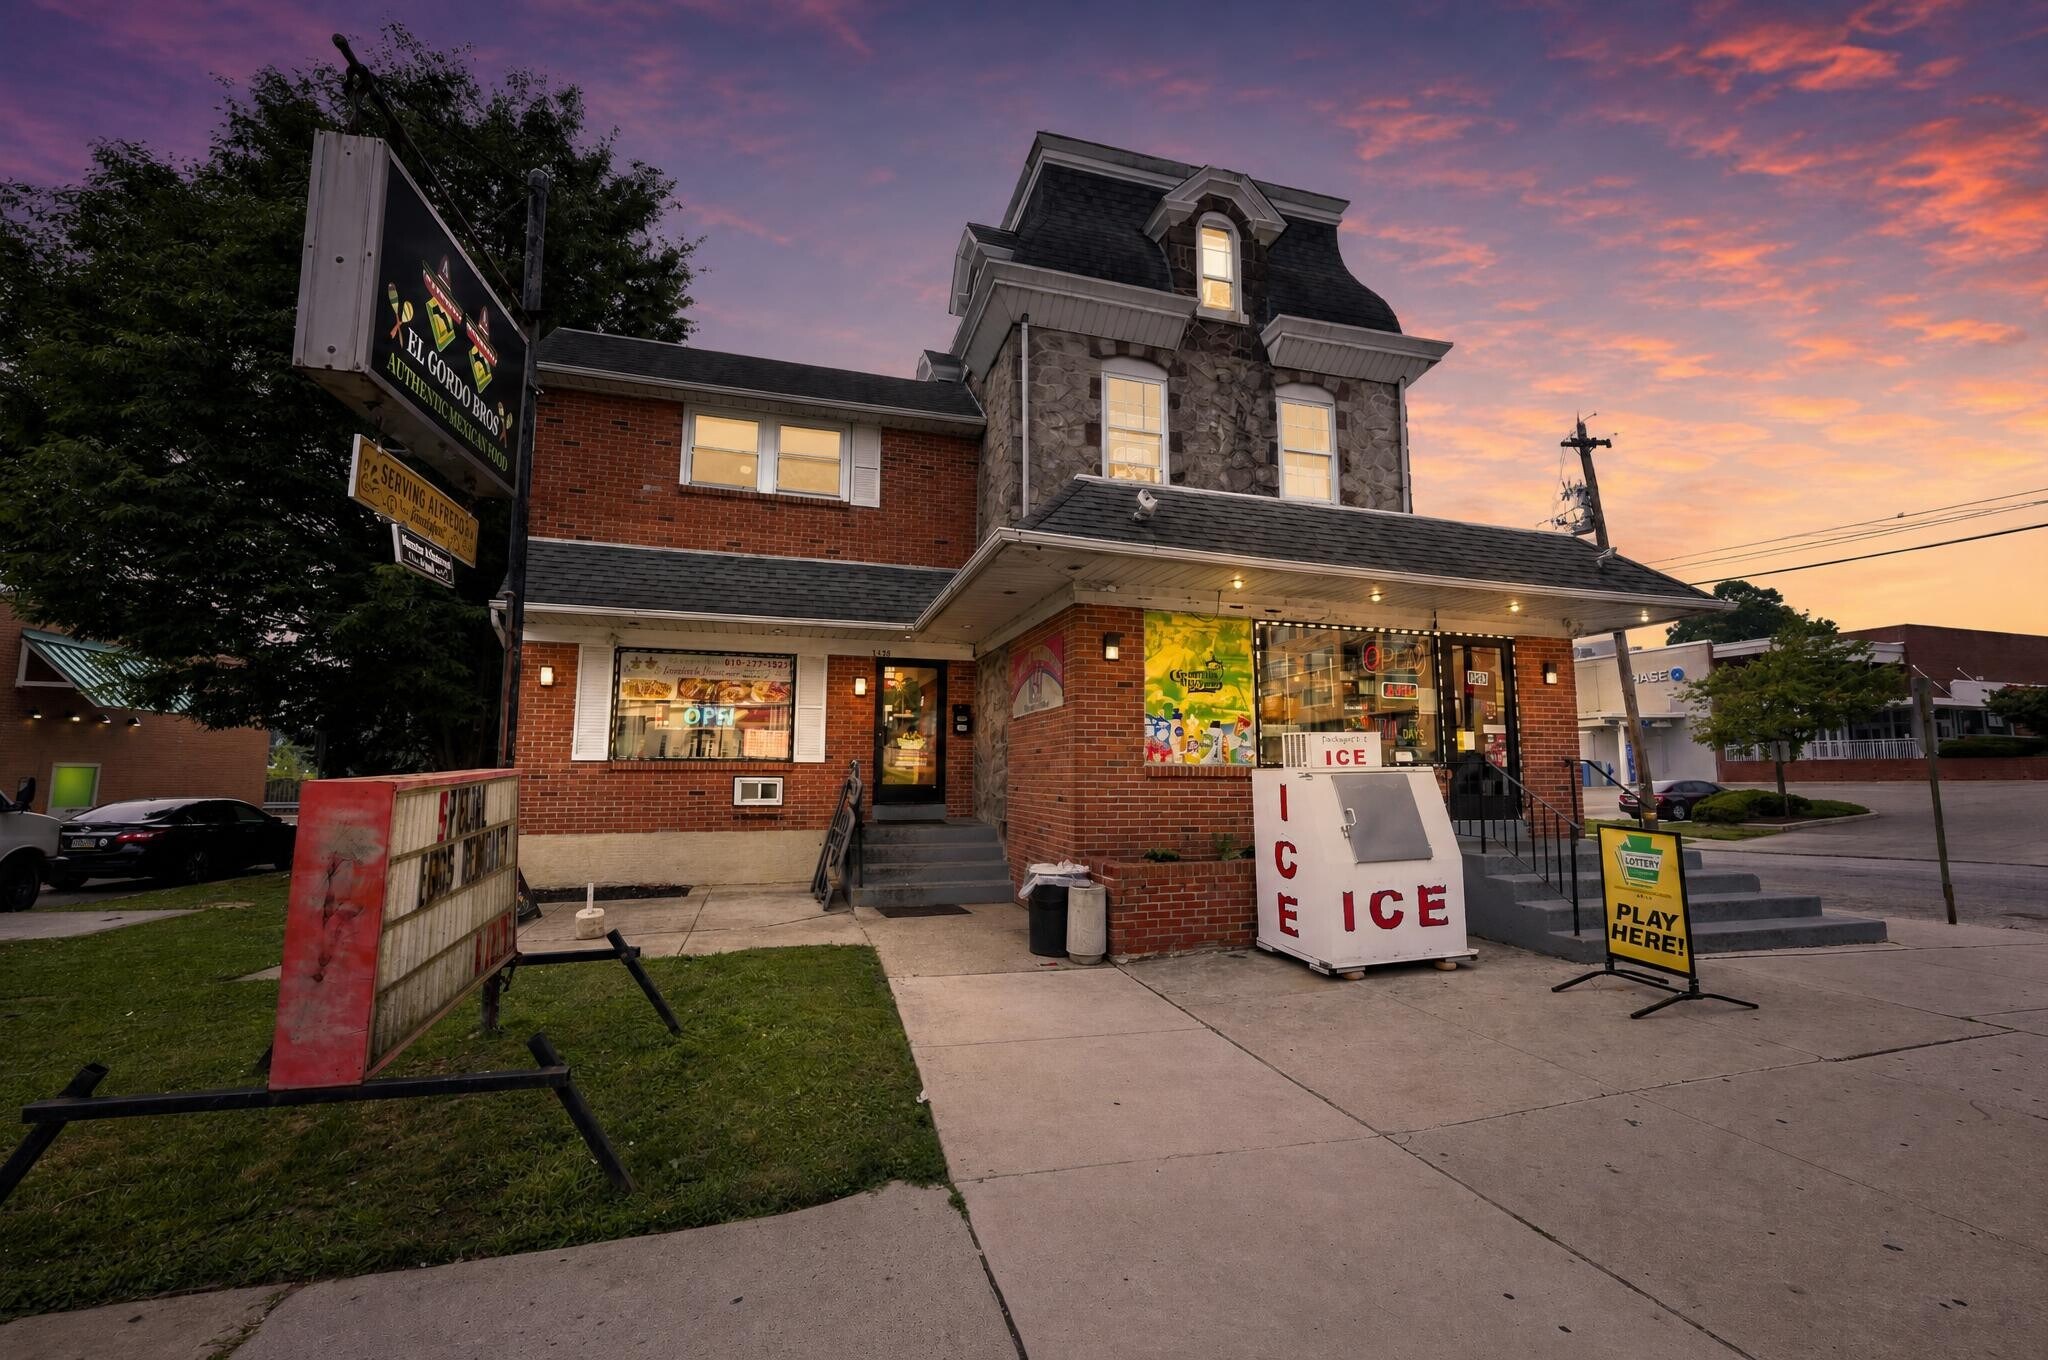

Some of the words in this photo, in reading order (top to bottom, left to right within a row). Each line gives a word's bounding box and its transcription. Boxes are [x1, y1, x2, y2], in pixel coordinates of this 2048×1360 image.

[406, 327, 425, 365] EL
[427, 350, 470, 408] GORDO
[472, 393, 499, 436] BROS
[387, 353, 448, 419] AUTHENTIC
[449, 407, 487, 453] MEXICAN
[487, 444, 508, 472] FOOD
[381, 464, 426, 508] SERVING
[1403, 729, 1424, 741] DAYS
[1326, 750, 1367, 765] ICE
[1275, 783, 1299, 938] ICE
[1625, 857, 1659, 869] LOTTERY
[1343, 885, 1448, 932] ICE
[1617, 903, 1679, 931] PLAY
[1611, 923, 1684, 956] HERE!
